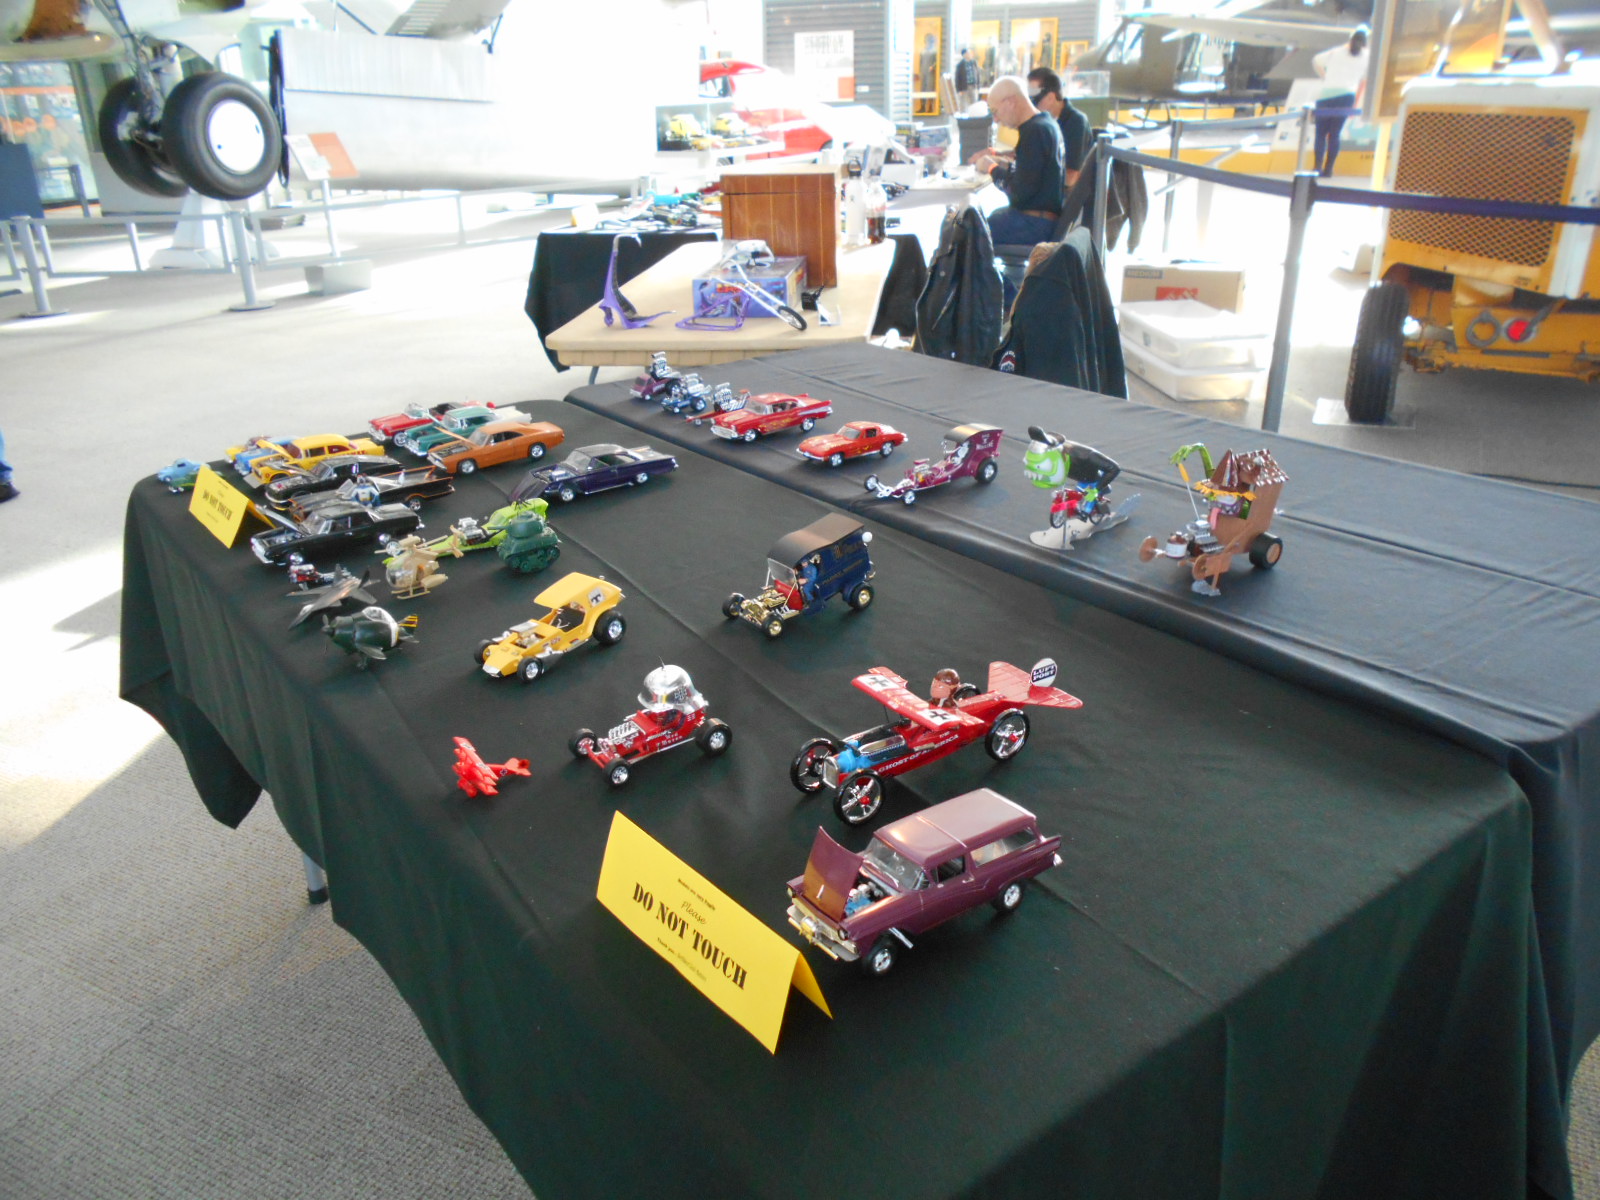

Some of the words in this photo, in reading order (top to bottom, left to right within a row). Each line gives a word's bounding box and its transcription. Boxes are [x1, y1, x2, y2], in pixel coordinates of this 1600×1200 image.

[1033, 669, 1056, 681] POST
[878, 757, 910, 772] GHOST
[681, 900, 708, 925] Please
[633, 881, 654, 912] DO
[655, 899, 689, 939] NOT
[692, 928, 748, 991] TOUCH
